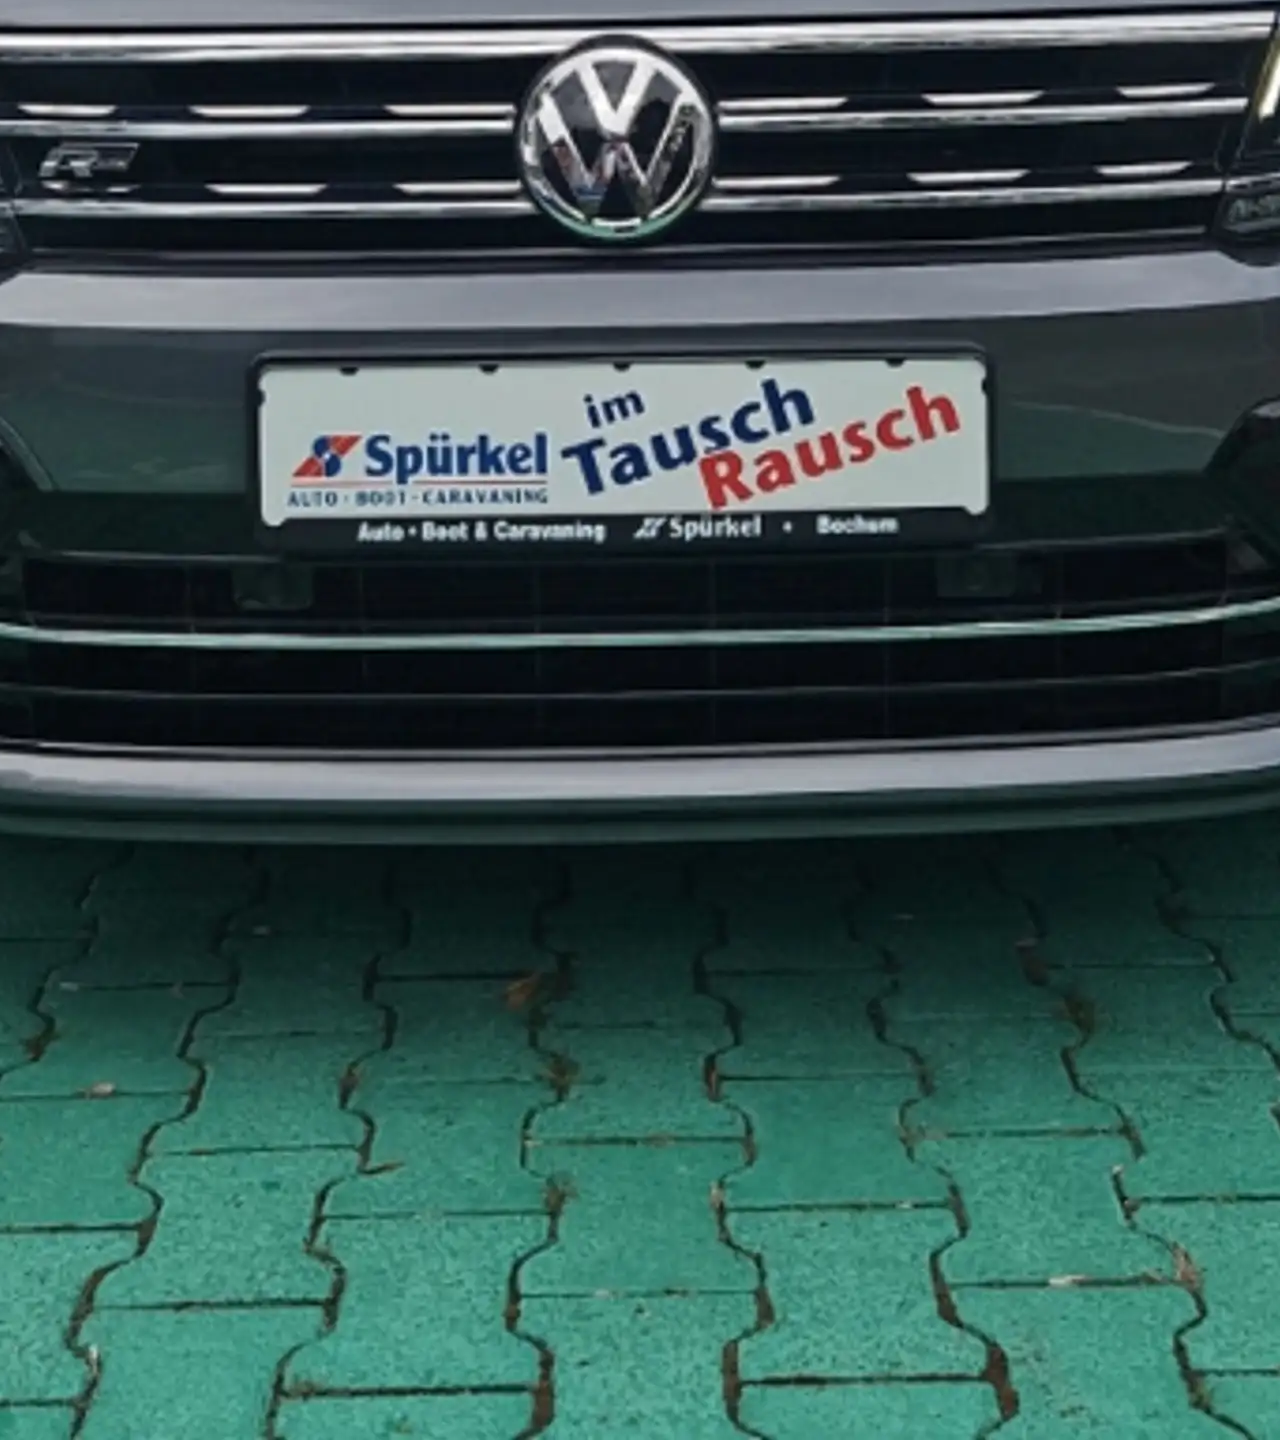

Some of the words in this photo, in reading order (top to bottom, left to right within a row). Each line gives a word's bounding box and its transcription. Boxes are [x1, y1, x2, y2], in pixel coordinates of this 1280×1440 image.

[583, 389, 646, 429] im
[364, 432, 548, 485] Spürkel
[561, 377, 816, 497] Tausch
[696, 384, 961, 511] Rausch
[286, 491, 338, 508] AUTO
[355, 491, 407, 507] BOOT
[422, 487, 549, 506] CARAVANING
[357, 521, 405, 542] Auto
[422, 521, 468, 542] Boot
[493, 520, 607, 543] Caravaning
[669, 514, 762, 540] Spürkel
[815, 514, 900, 536] Bochum
